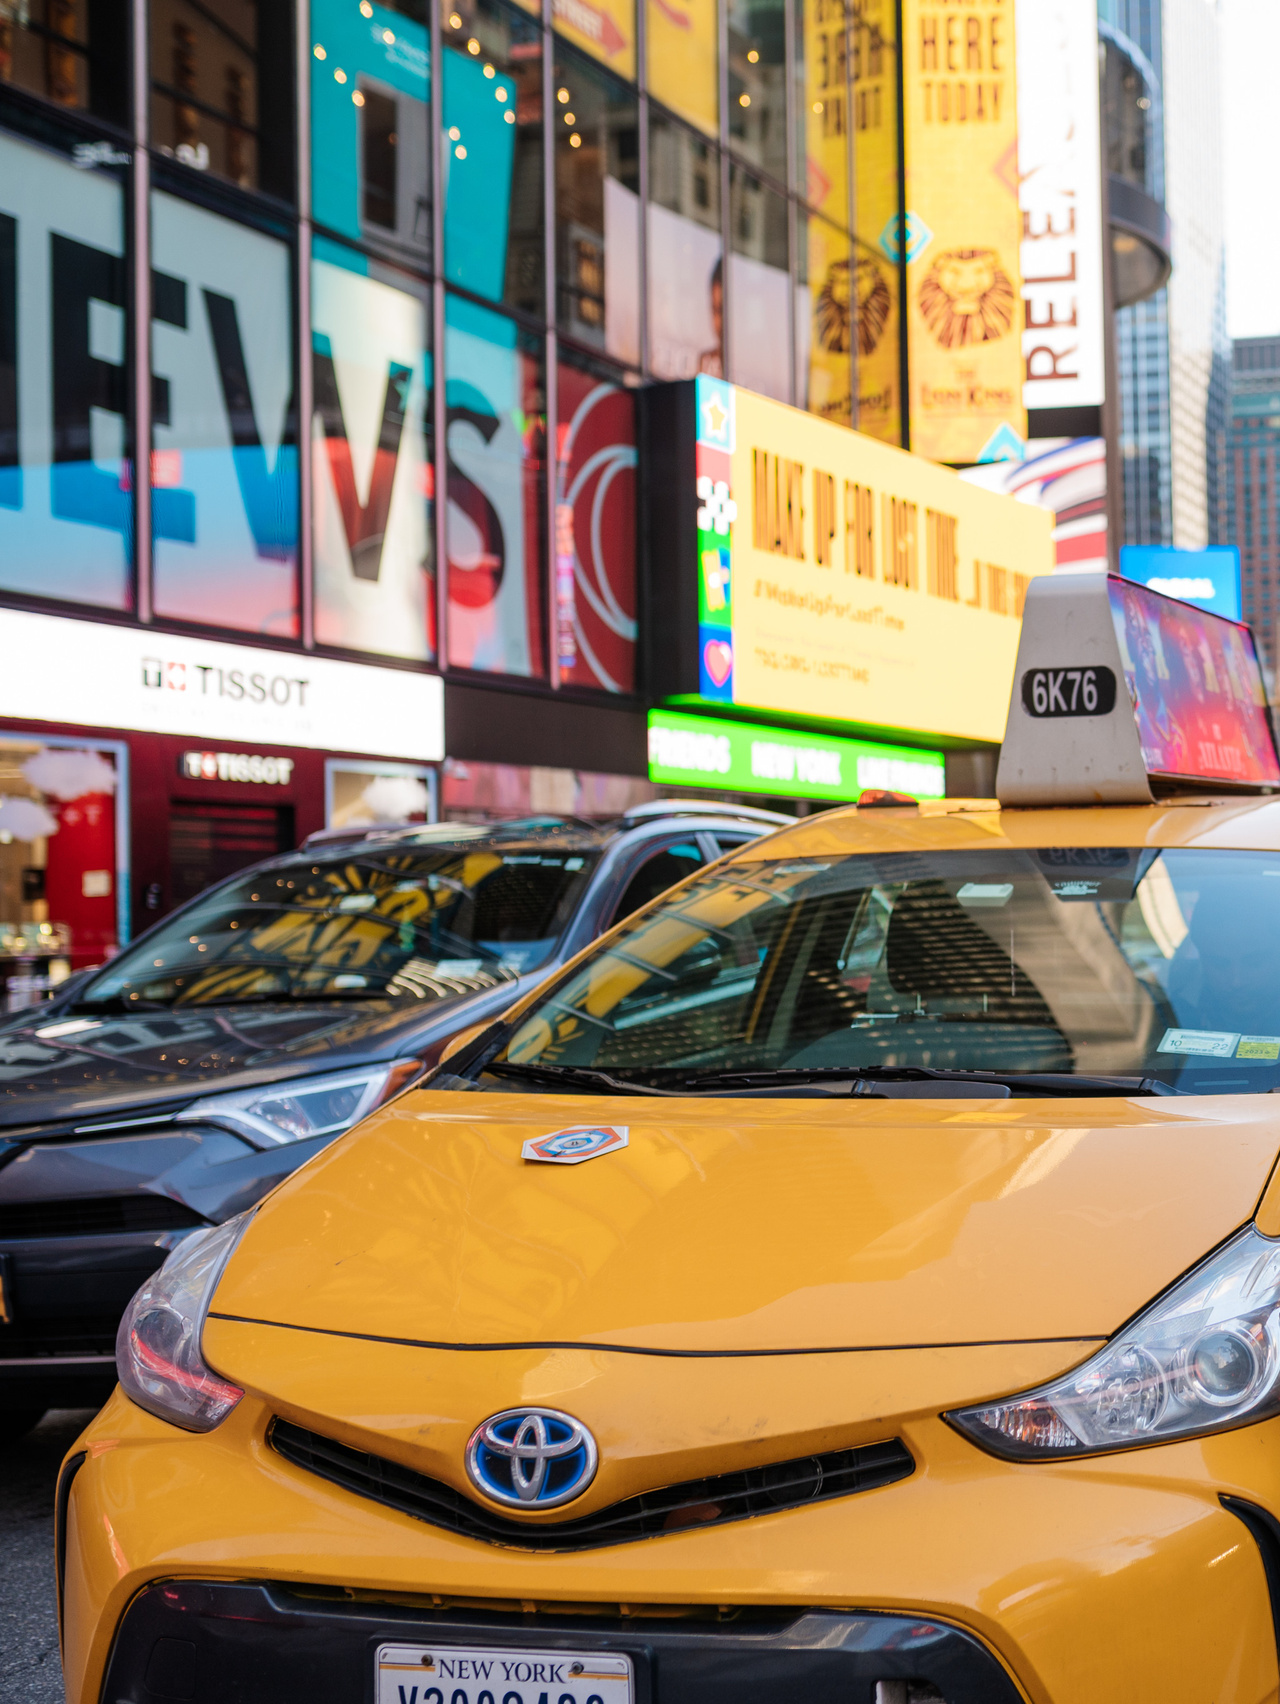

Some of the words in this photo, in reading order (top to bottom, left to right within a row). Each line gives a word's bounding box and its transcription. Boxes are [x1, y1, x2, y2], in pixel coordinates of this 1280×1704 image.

[919, 16, 1004, 71] HERE
[924, 80, 1003, 123] TODAY
[194, 664, 310, 706] TISSOT
[1032, 669, 1098, 714] 6K76
[216, 752, 294, 786] TISSOT
[1212, 1043, 1228, 1051] 22
[438, 1659, 494, 1681] NEW
[500, 1661, 567, 1684] YORK
